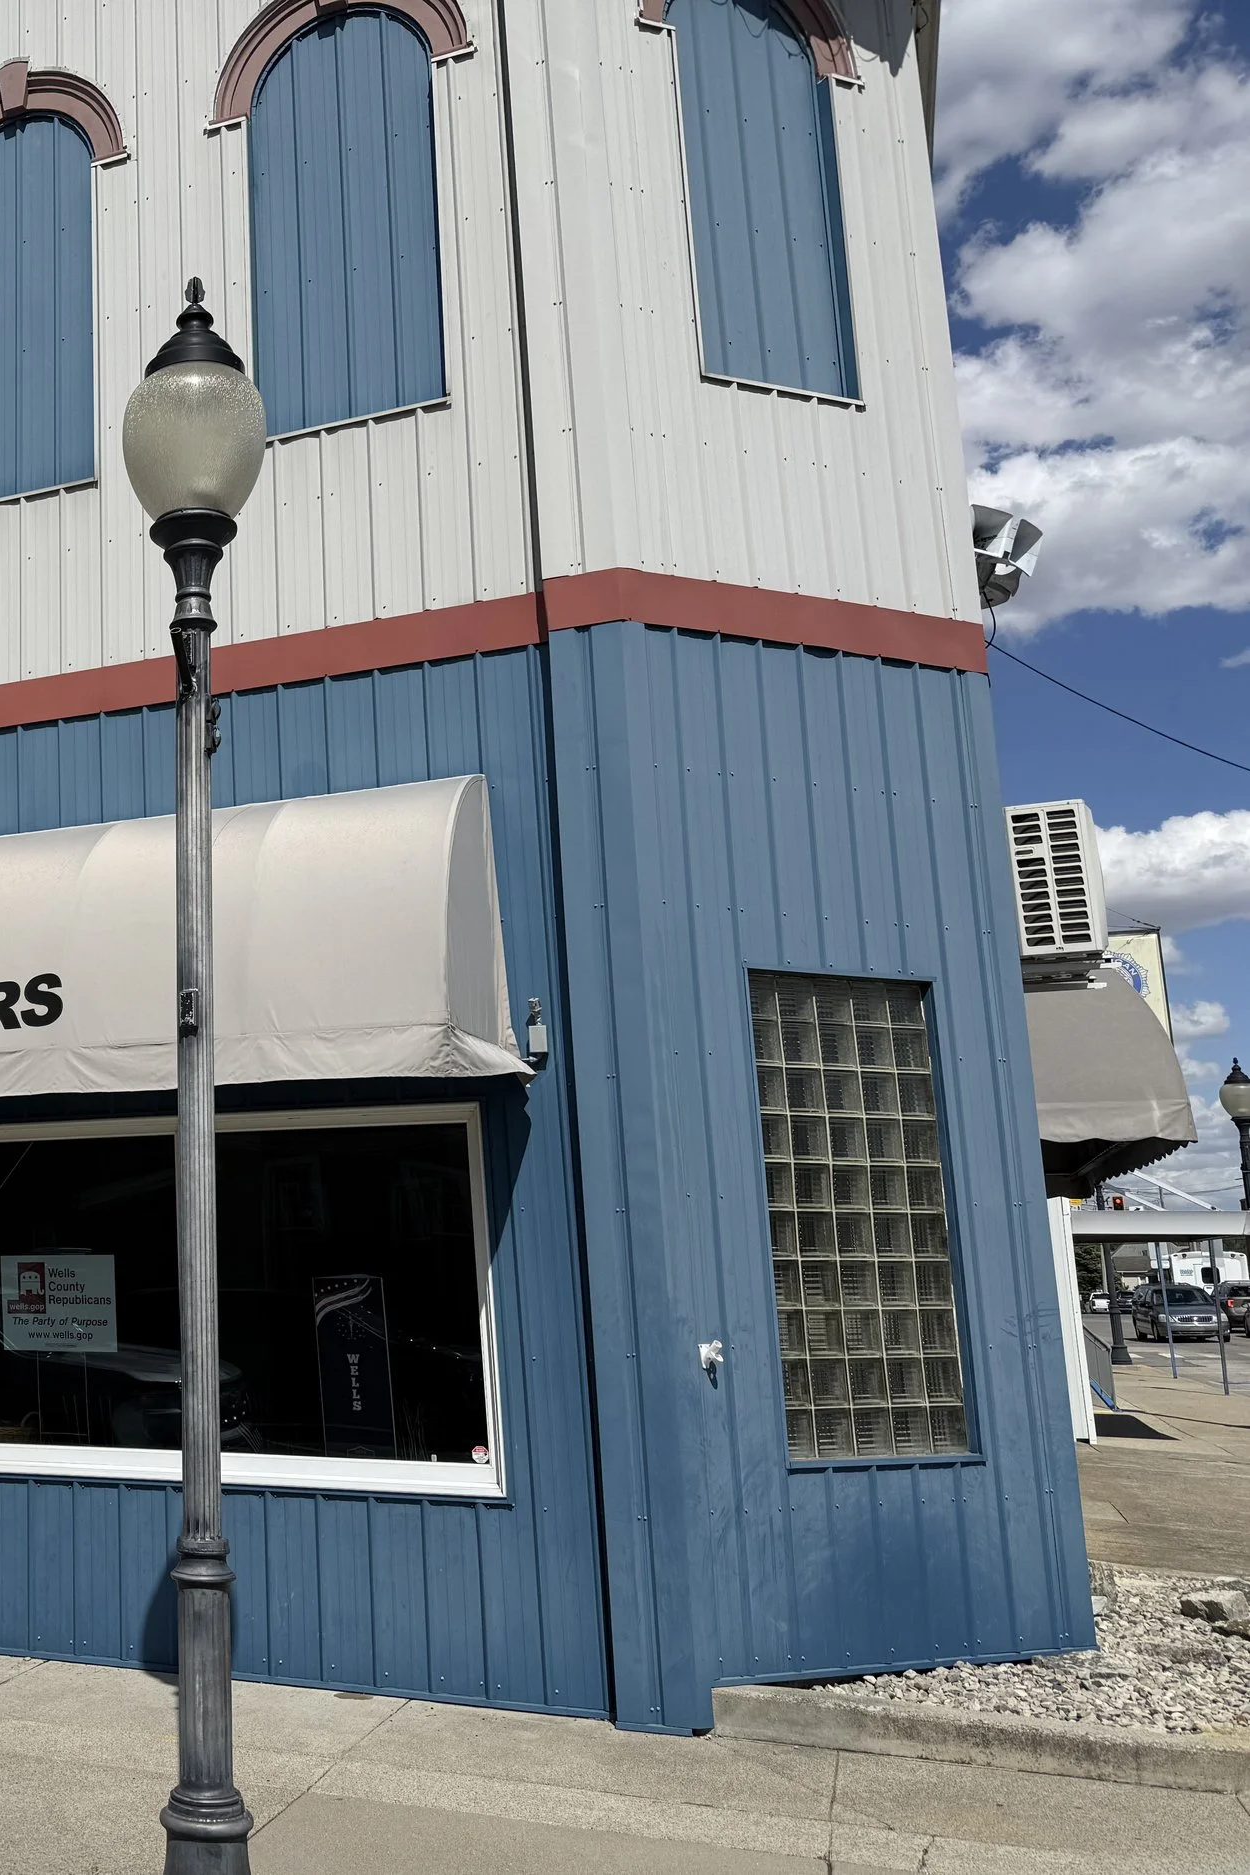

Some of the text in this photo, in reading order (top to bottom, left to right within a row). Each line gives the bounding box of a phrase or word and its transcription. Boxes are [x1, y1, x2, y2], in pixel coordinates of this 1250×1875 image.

[48, 1268, 76, 1279] Wells
[48, 1281, 85, 1294] County
[48, 1295, 112, 1307] Republicans
[9, 1303, 45, 1312] wells.gop
[12, 1316, 108, 1328] The Party of Purpose
[28, 1331, 93, 1341] www.wells.gop
[347, 1353, 362, 1411] WELLS
